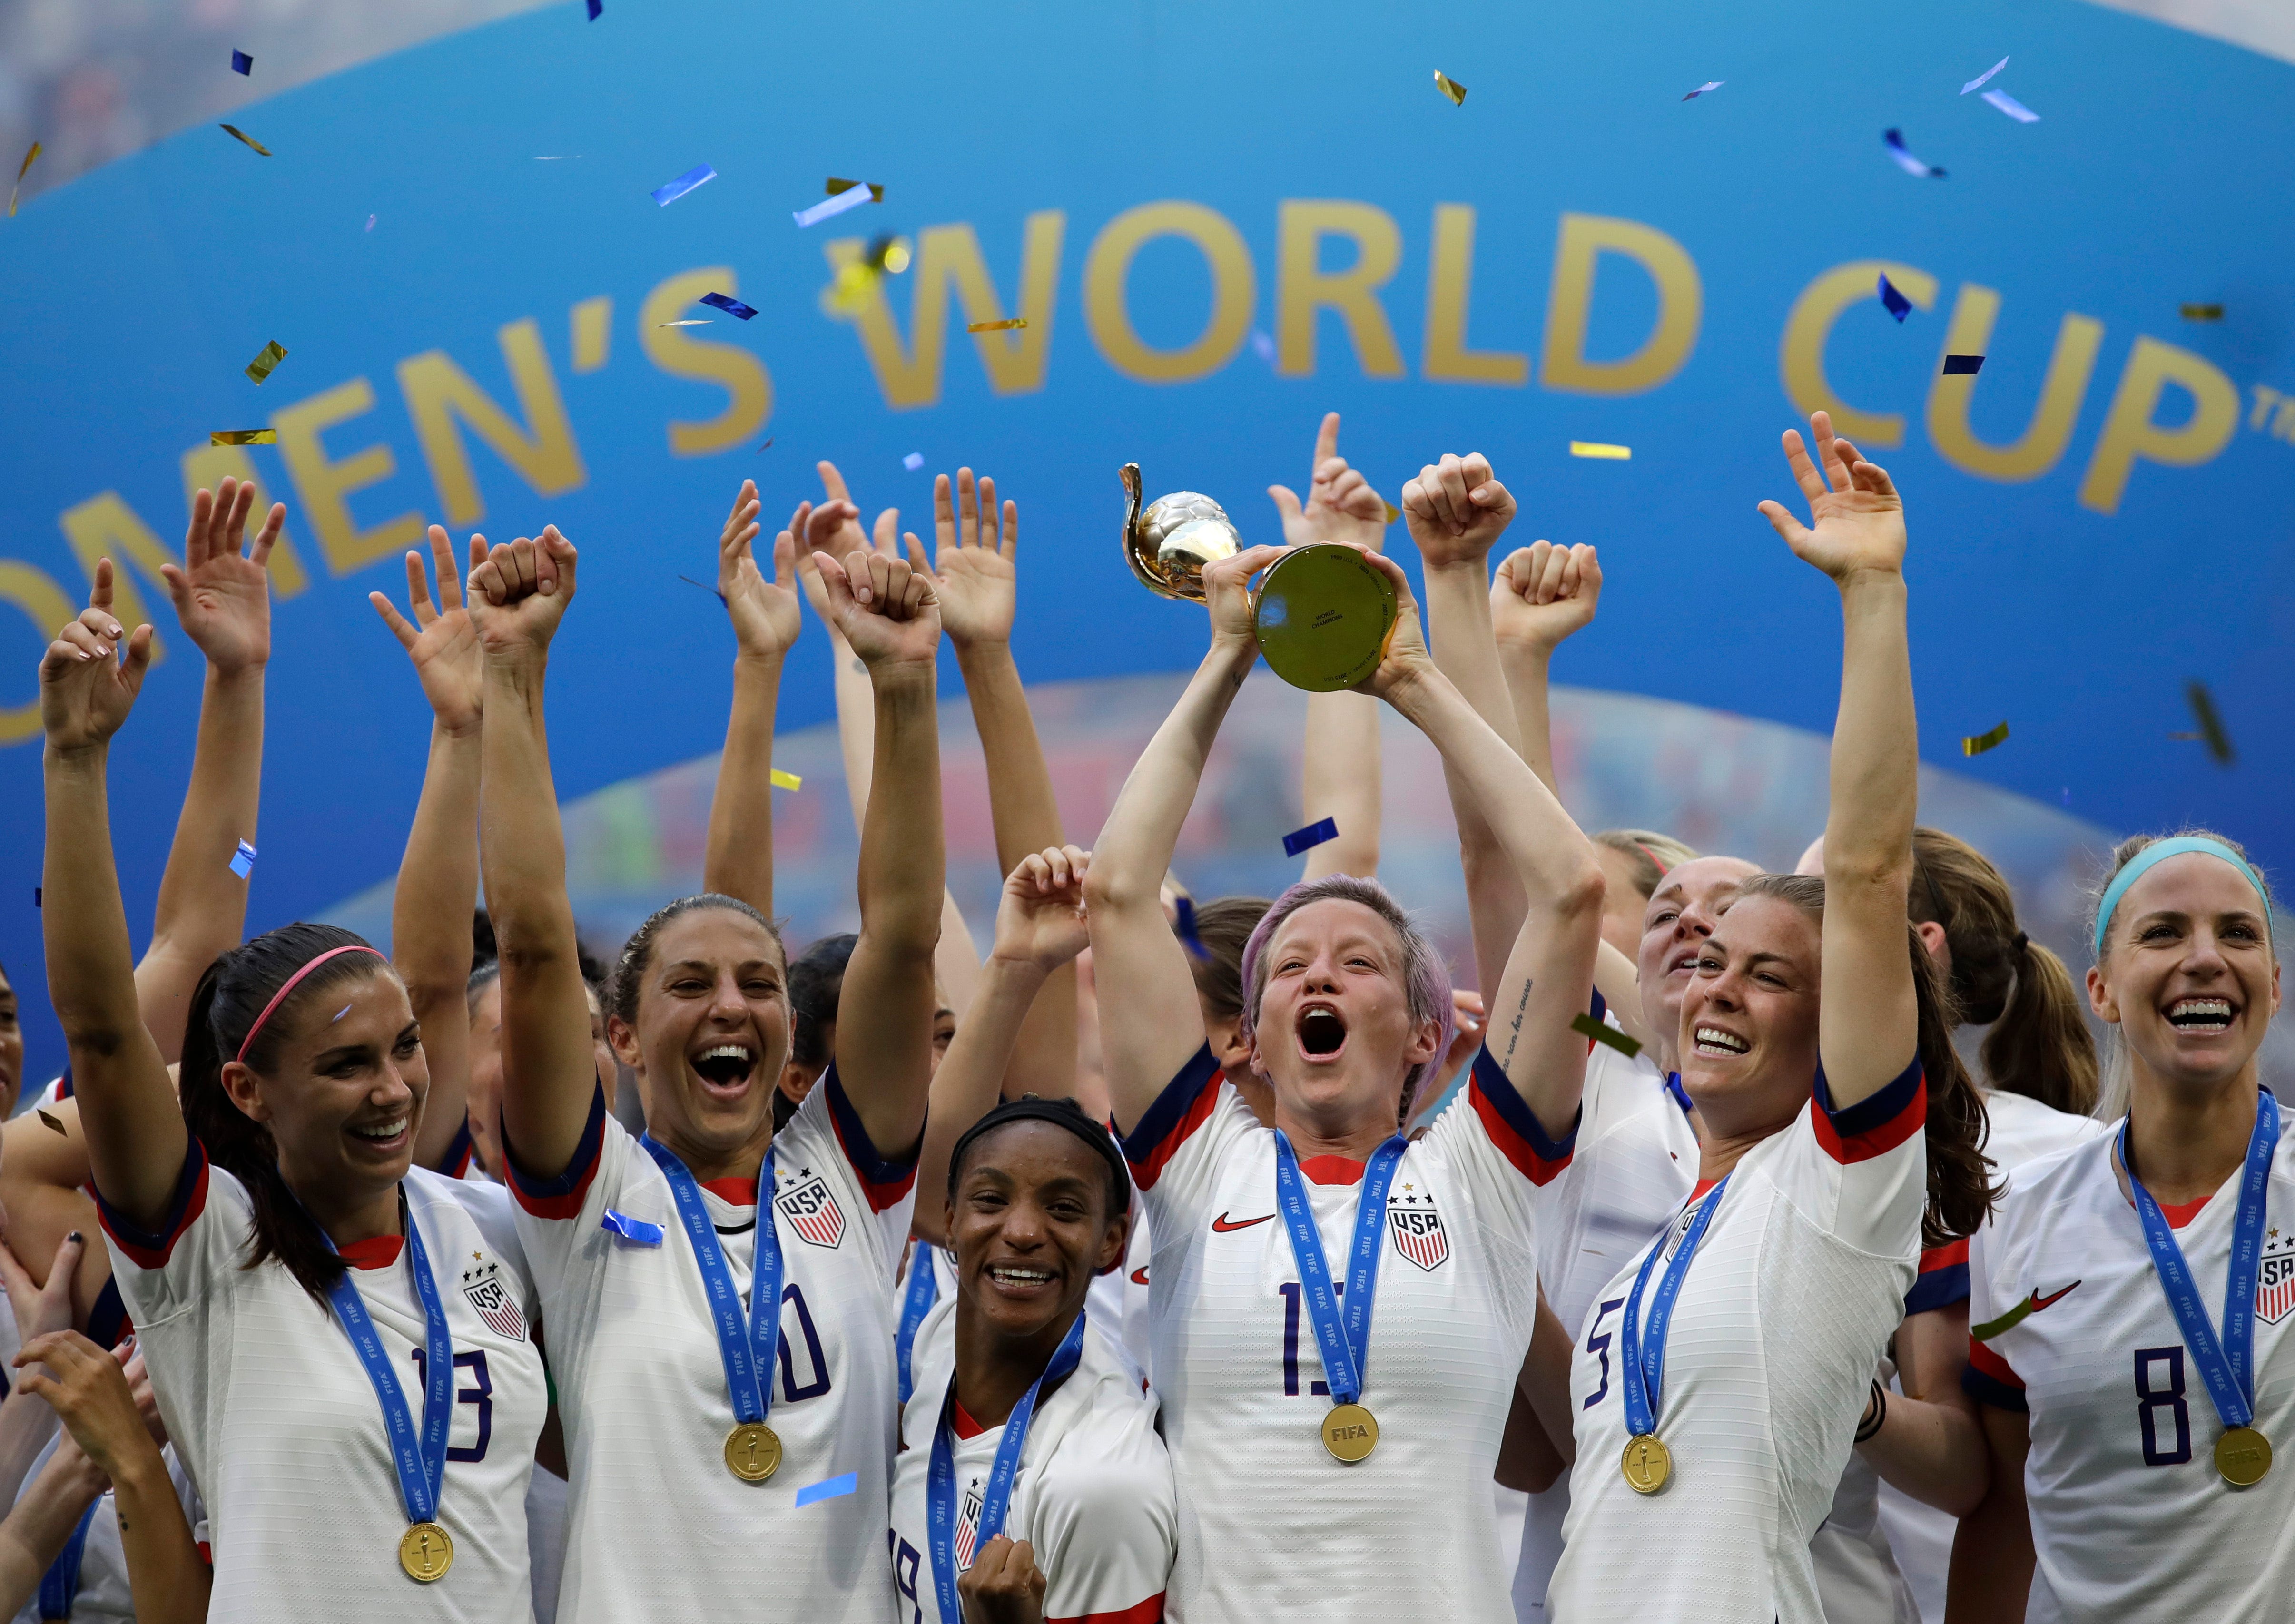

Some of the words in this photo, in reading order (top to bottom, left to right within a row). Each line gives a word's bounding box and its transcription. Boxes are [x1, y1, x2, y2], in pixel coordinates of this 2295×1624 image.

[822, 198, 1704, 412] WORLD
[1780, 258, 2240, 516] CUP
[1316, 610, 1335, 620] WORLD
[1359, 564, 1369, 574] 2003
[1366, 649, 1376, 661] 2011
[1520, 979, 1533, 1011] course
[1511, 1013, 1523, 1032] her
[1507, 1034, 1517, 1055] ran
[782, 1183, 826, 1214] USA
[1393, 1213, 1438, 1235] USA
[2259, 1258, 2294, 1286] SA
[470, 1283, 503, 1309] USA
[1582, 1296, 1626, 1411] 5
[2134, 1345, 2193, 1467] 8
[1331, 1424, 1369, 1441] FIFA
[2225, 1447, 2261, 1466] FIFA
[888, 1527, 922, 1624] 9
